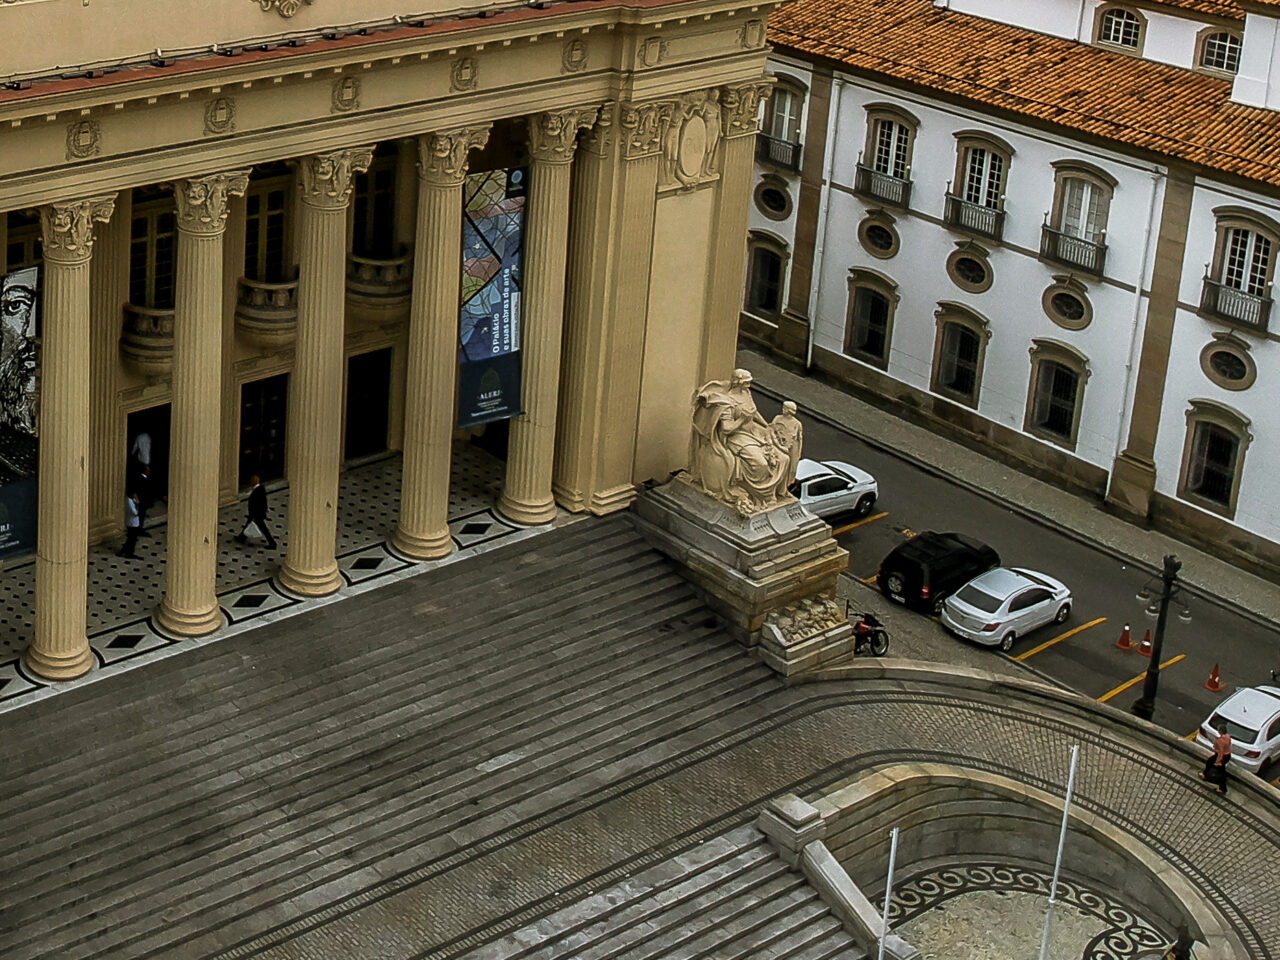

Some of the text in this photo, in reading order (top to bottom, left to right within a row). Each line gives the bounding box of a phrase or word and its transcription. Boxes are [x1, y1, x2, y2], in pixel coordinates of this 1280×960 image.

[502, 287, 510, 298] de
[502, 299, 510, 323] obras
[492, 313, 500, 345] Palácio
